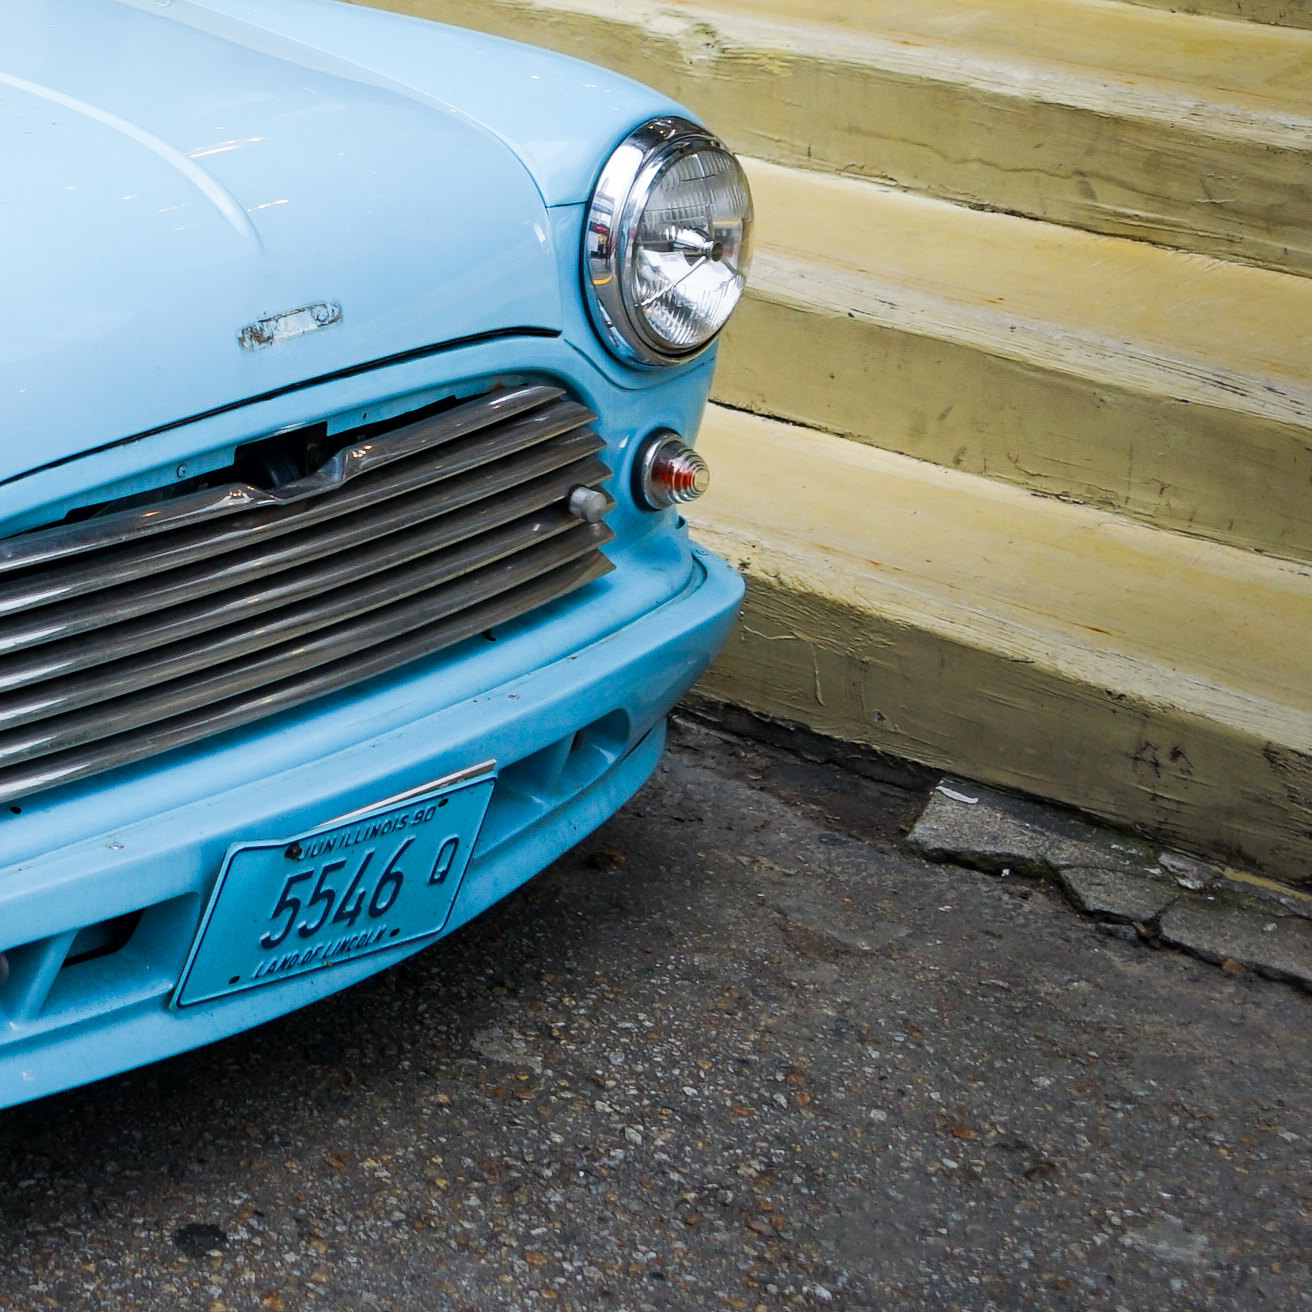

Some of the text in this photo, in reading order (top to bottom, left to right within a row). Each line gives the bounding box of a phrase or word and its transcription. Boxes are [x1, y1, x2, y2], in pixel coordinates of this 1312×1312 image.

[297, 838, 337, 862] JUN
[338, 812, 410, 849] ILLINOIS
[259, 832, 460, 950] 5546 Q
[251, 924, 388, 980] LAND OF LINCOLN
